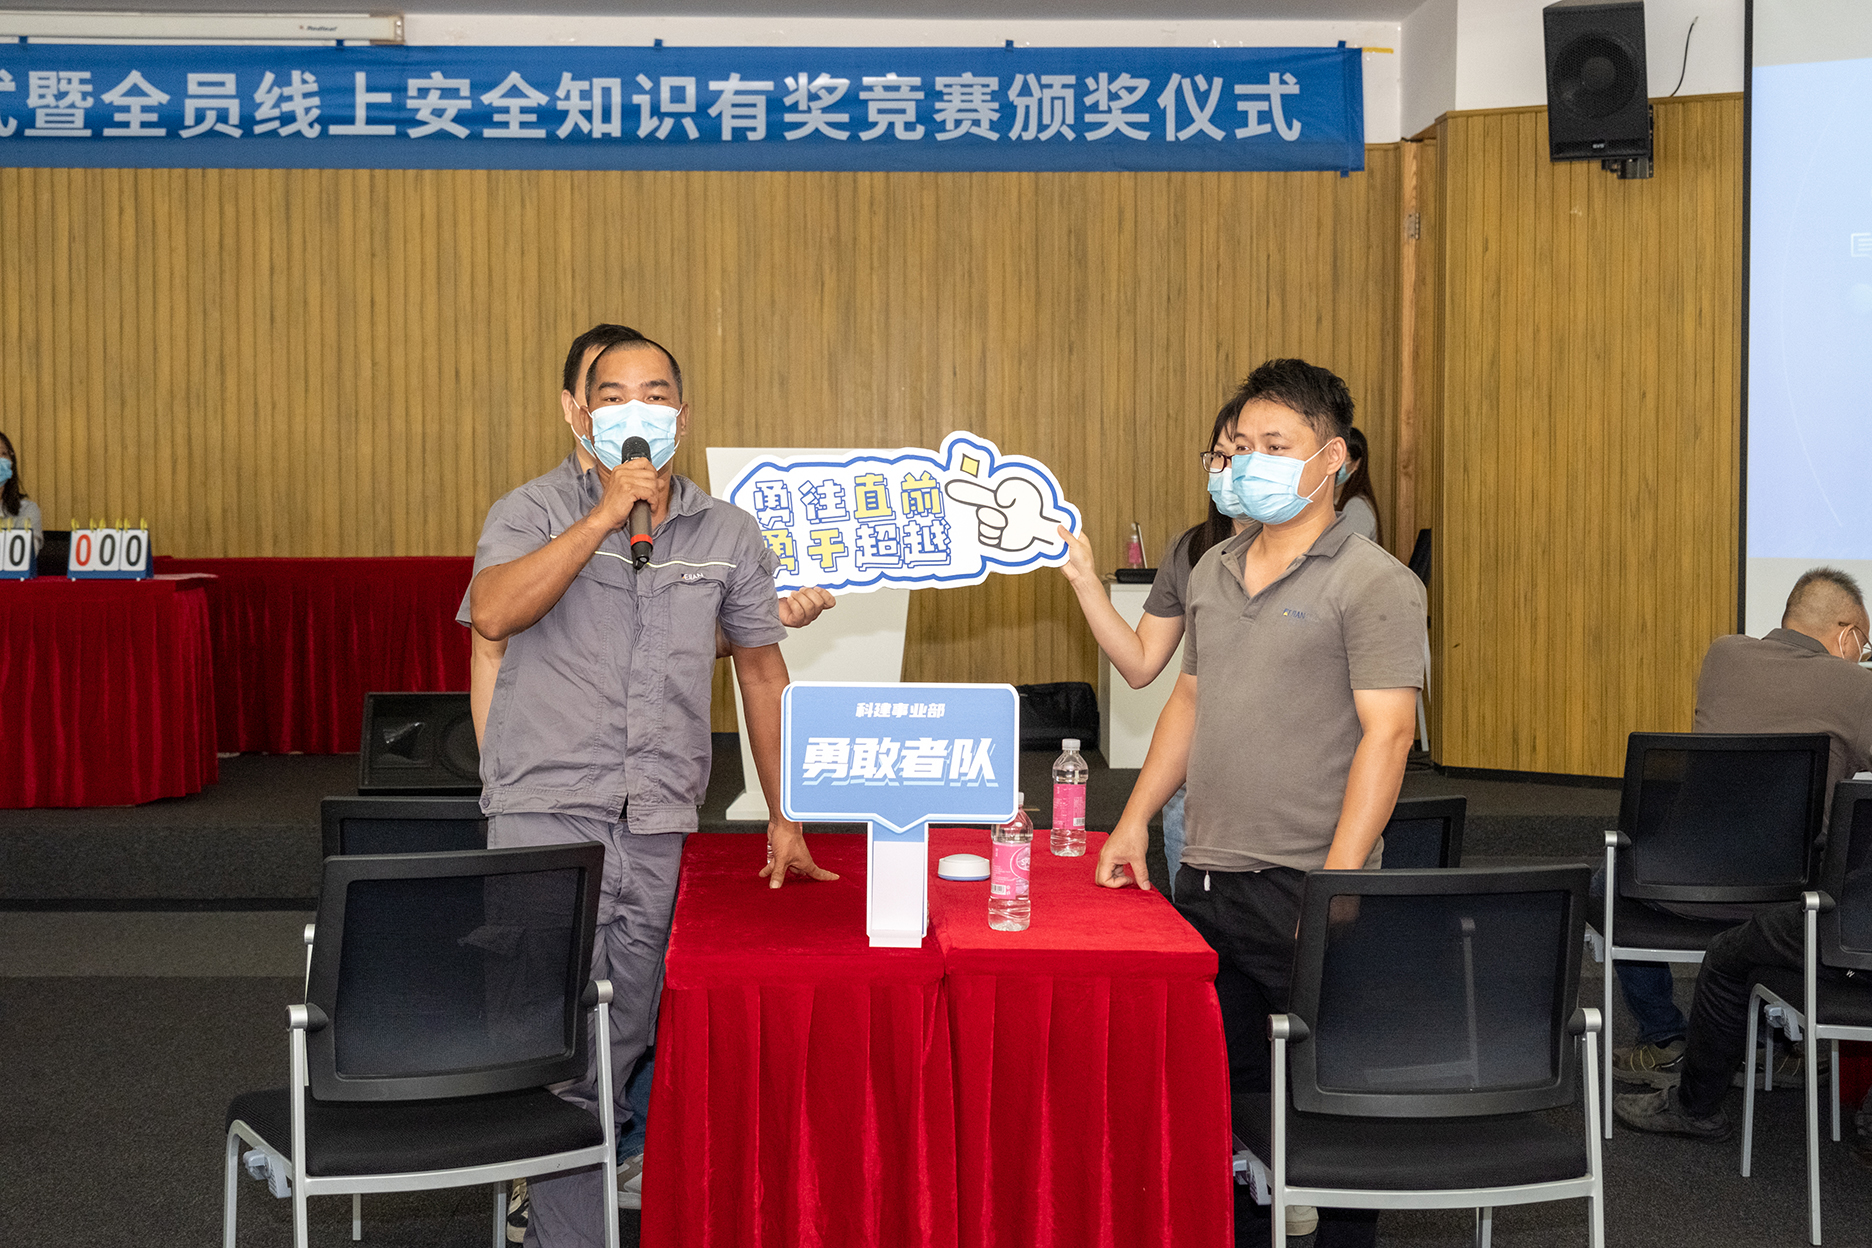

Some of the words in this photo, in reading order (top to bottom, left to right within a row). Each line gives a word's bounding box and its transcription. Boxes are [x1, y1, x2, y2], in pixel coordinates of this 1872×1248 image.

[855, 702, 946, 718] 科建事业部
[802, 737, 999, 787] 勇敢者队
